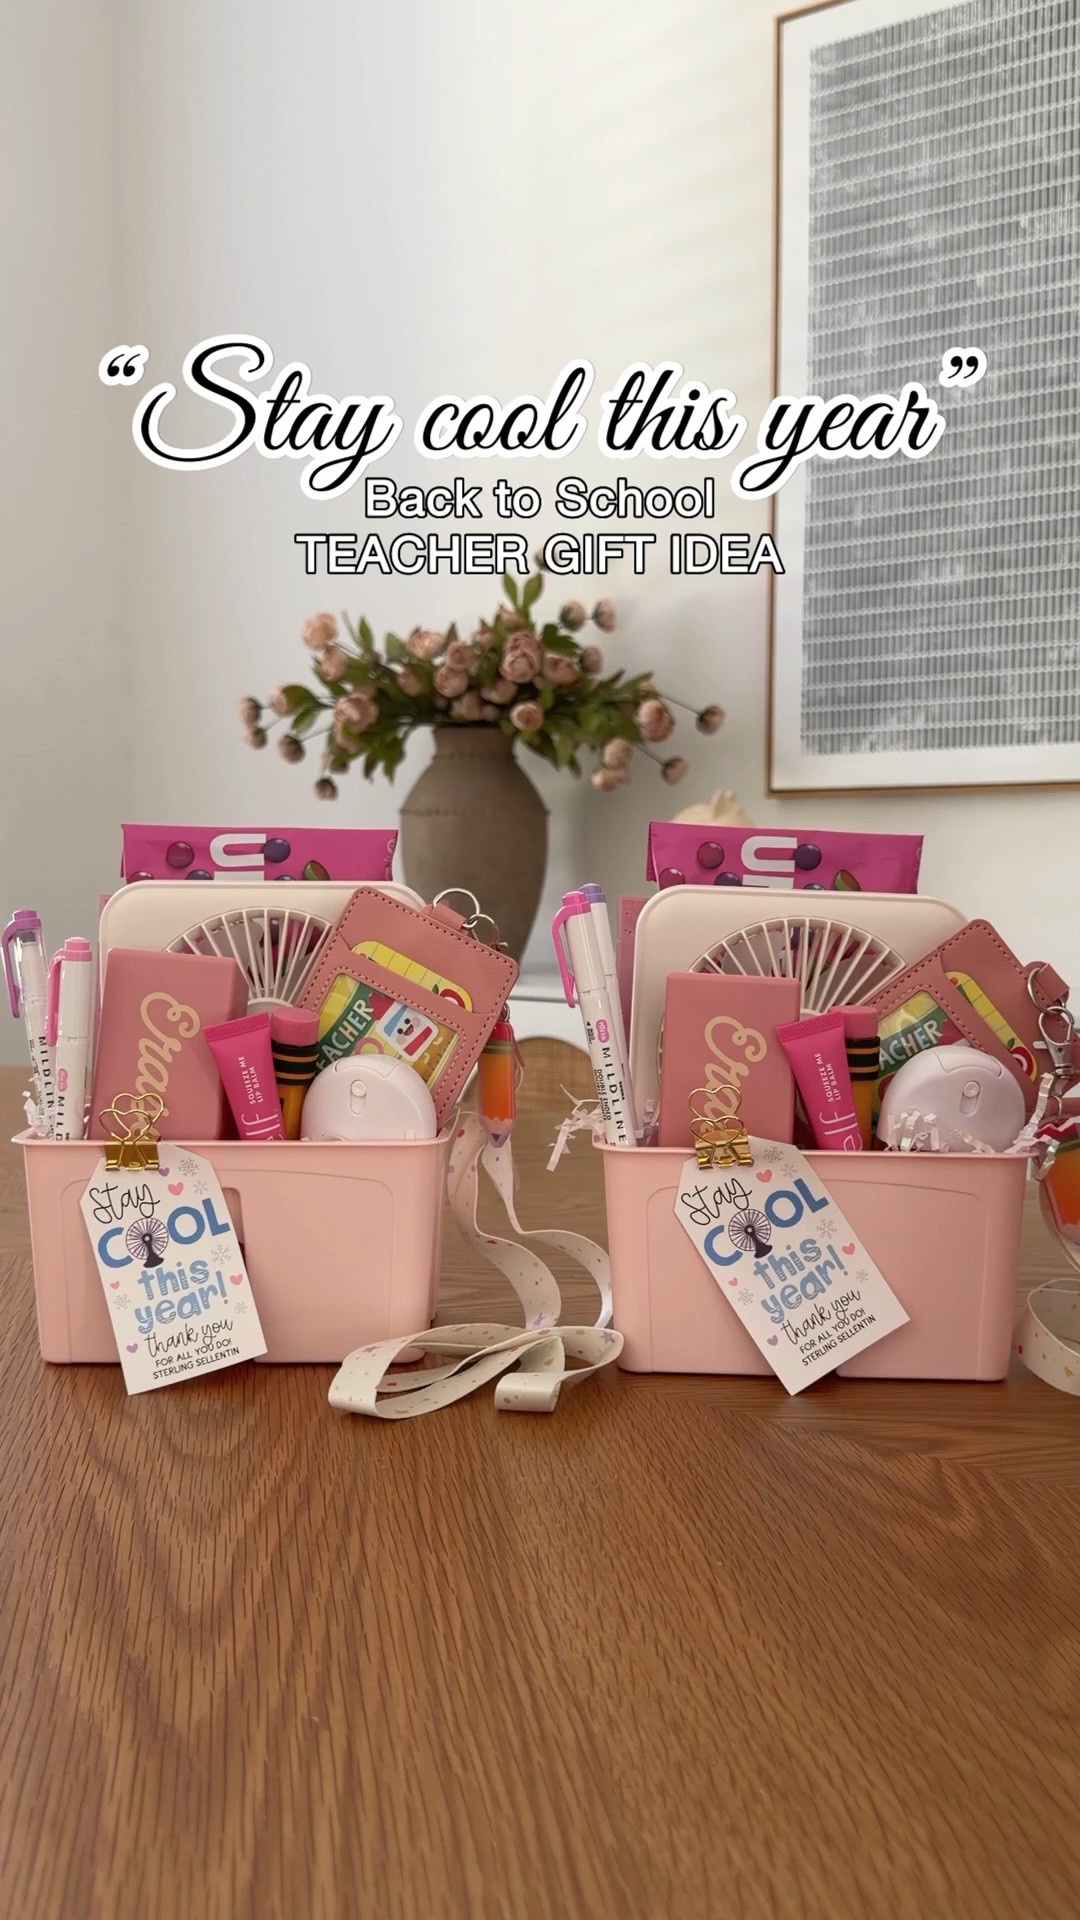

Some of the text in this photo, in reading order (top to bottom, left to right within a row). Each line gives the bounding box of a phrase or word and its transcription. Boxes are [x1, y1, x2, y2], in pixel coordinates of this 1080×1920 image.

[238, 1056, 256, 1105] SQUEEZE ME
[249, 1066, 264, 1103] LIP BALM
[814, 1052, 835, 1102] SQUEEZE ME
[826, 1063, 842, 1101] LIP BALM
[89, 1182, 160, 1224] Stay
[681, 1178, 753, 1226] Stay
[138, 1259, 210, 1300] this
[753, 1238, 822, 1290] this
[760, 1243, 849, 1325] year!
[134, 1270, 229, 1334] year!
[781, 1290, 861, 1346] thank you
[144, 1318, 233, 1358] thank you
[155, 1337, 232, 1368] FOR ALL YOU DO!
[799, 1307, 865, 1355] FOR ALL YOU DO!
[801, 1314, 877, 1366] STERLING SELLENTIN
[153, 1346, 240, 1380] STERLING SELLENTIN
